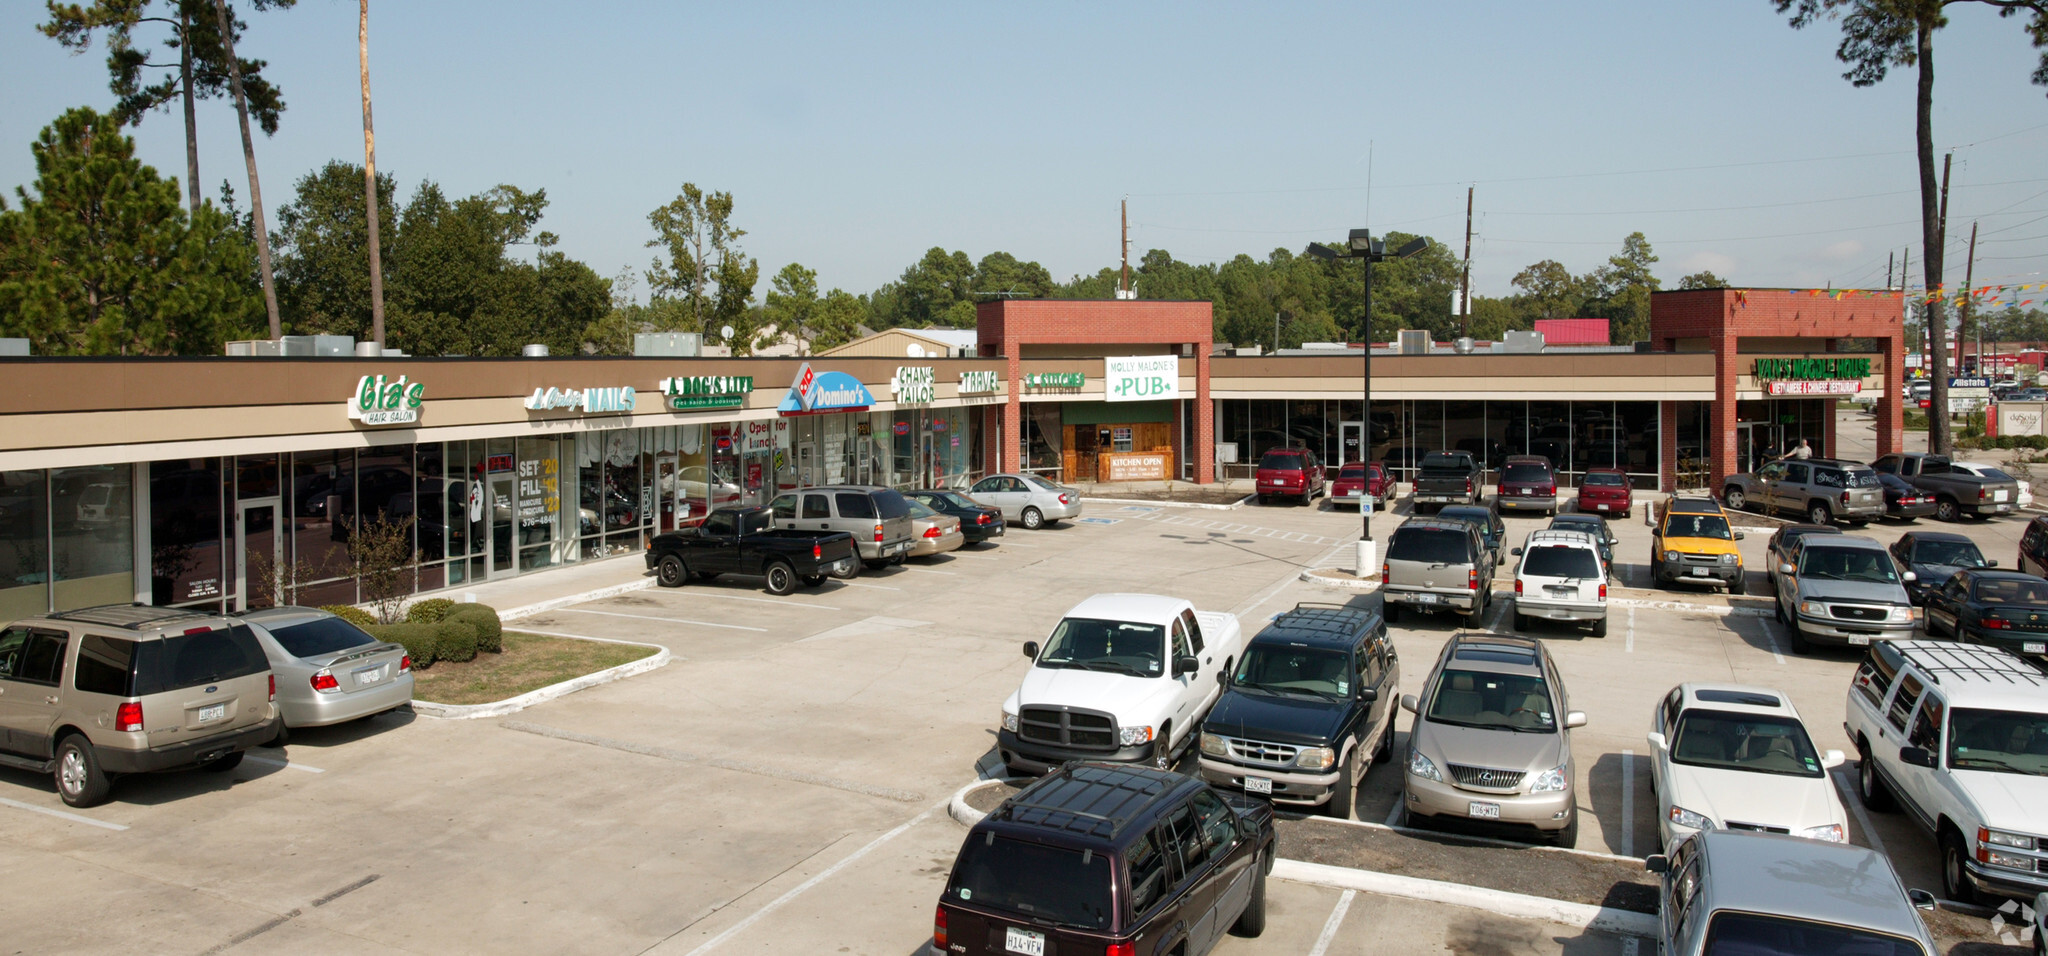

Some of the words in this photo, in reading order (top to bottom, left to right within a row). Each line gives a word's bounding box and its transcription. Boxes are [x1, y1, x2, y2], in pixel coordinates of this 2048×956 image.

[1110, 362, 1135, 373] MOLLY
[1138, 360, 1175, 372] MALONE'S
[1757, 358, 1791, 379] VAN'S
[1793, 358, 1835, 379] NOODLE
[1837, 357, 1871, 378] HOUSE
[898, 367, 935, 384] CHAN'S
[961, 371, 1000, 393] TRAVEL
[1026, 373, 1035, 388] 3
[1039, 372, 1086, 388] STITCHES
[1952, 379, 1986, 388] Allstate
[357, 374, 425, 411] Gia's
[667, 377, 679, 396] A
[682, 376, 722, 396] DOG'S
[725, 376, 754, 394] LIFE
[899, 386, 935, 403] TAILOR
[1121, 376, 1164, 397] PUB
[1772, 382, 1803, 395] VIETNAMESE
[1808, 381, 1828, 394] CHINESE
[1829, 381, 1859, 393] RESTAURANT
[584, 386, 636, 412] NAILS
[817, 383, 864, 407] Domino's
[368, 411, 388, 423] HAIR
[389, 410, 415, 423] SALON
[775, 419, 787, 431] for
[519, 459, 540, 478] SET
[1112, 458, 1142, 467] KITCHEN
[1143, 457, 1162, 466] OPEN
[520, 479, 542, 497] FILL
[950, 942, 966, 954] Jeep
